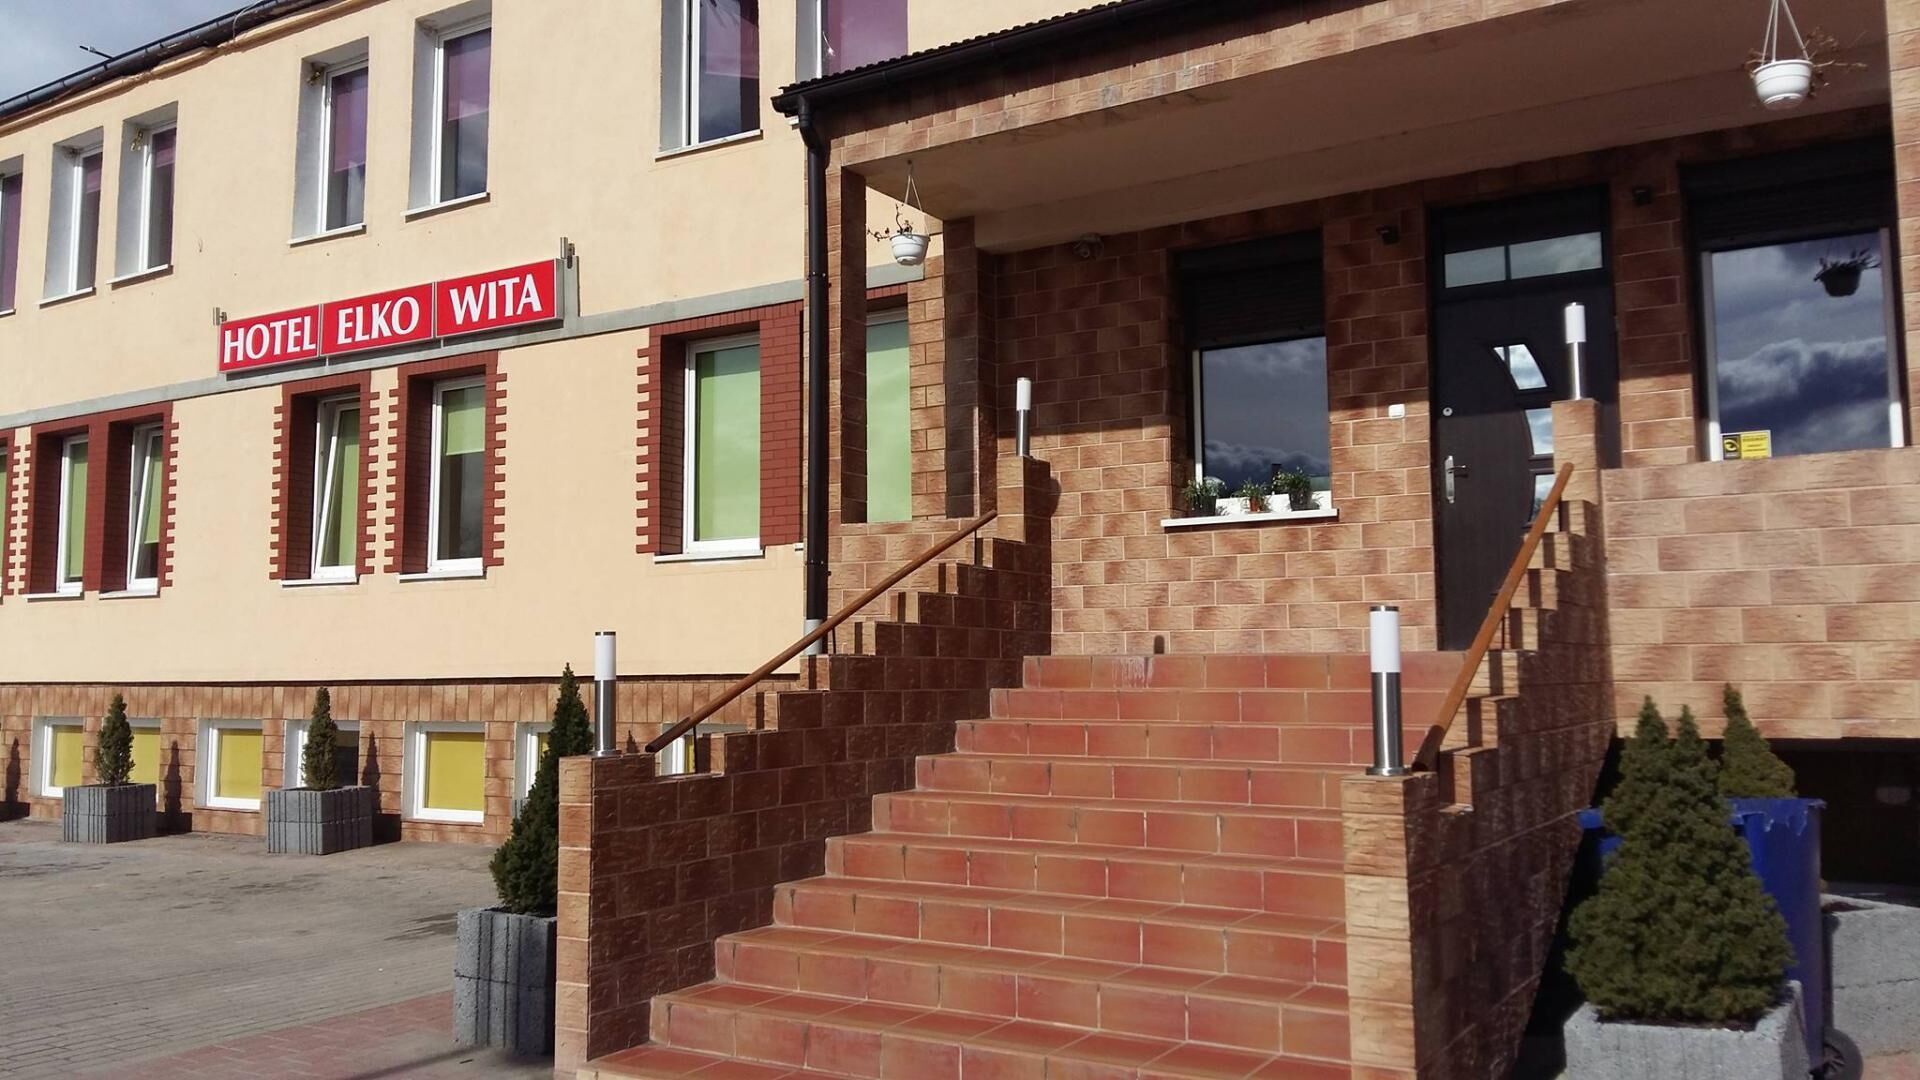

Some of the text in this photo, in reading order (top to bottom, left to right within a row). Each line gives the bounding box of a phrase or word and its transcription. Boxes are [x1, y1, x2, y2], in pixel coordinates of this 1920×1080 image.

[223, 273, 543, 364] HOTEL ELKO WITA
